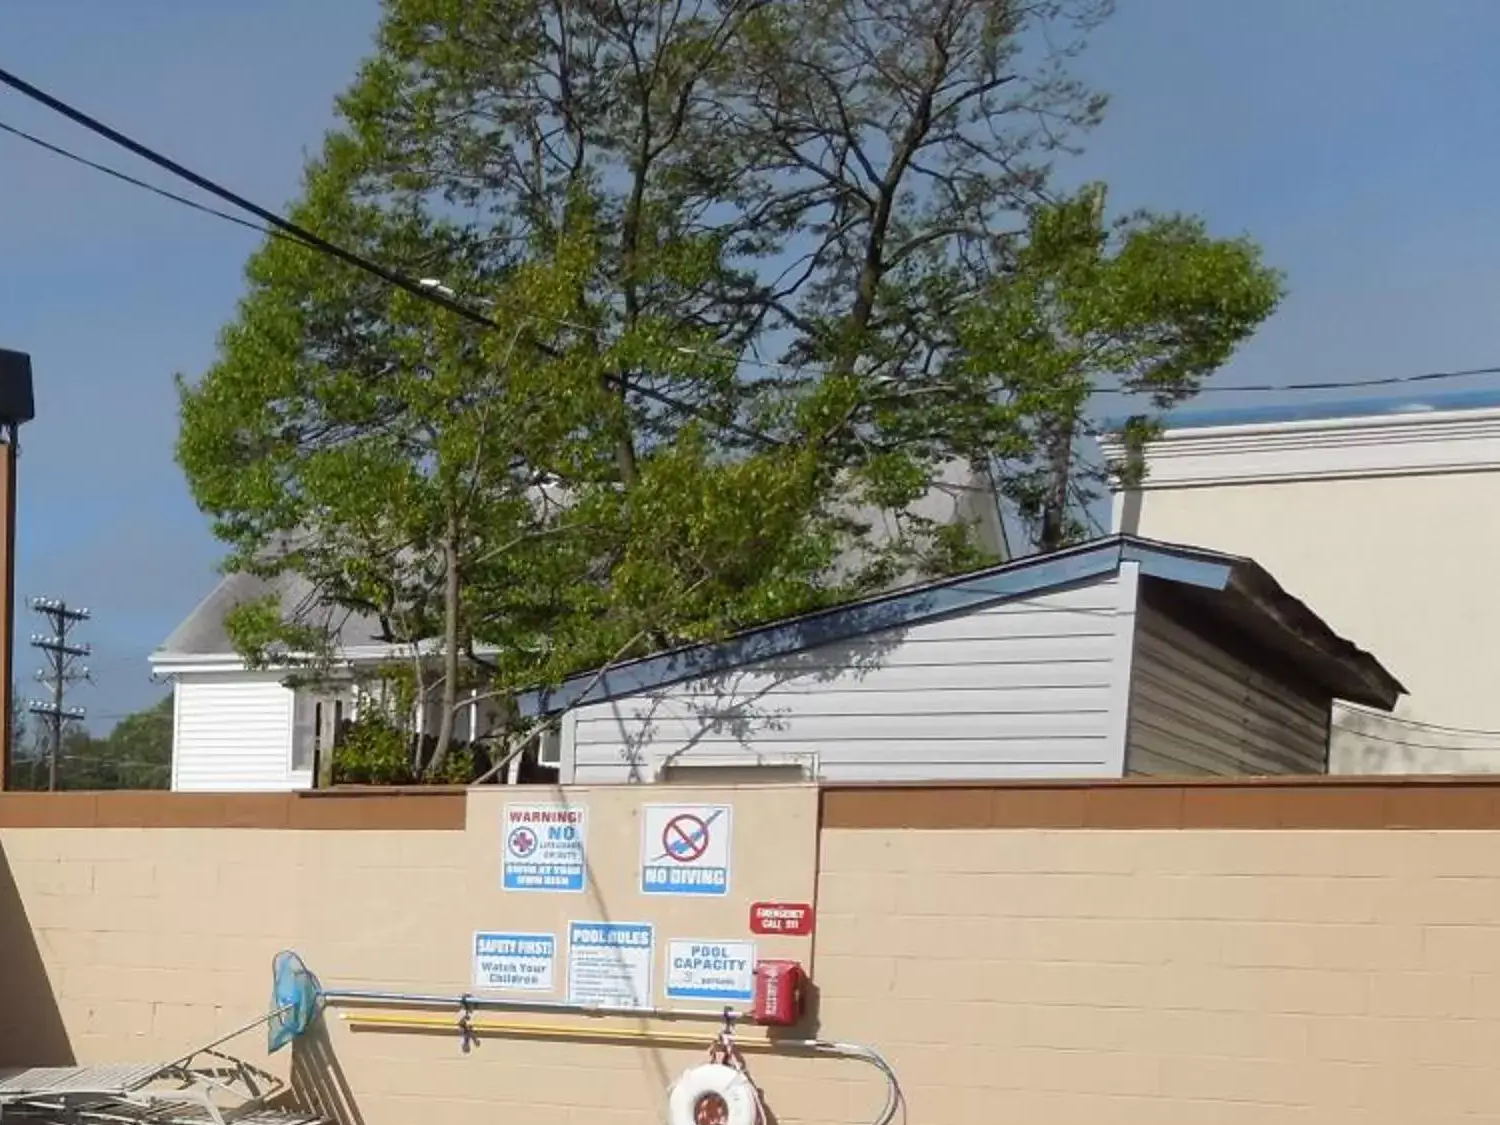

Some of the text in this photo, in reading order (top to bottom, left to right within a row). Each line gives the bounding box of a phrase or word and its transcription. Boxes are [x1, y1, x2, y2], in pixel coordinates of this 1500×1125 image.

[509, 811, 582, 823] WARNING!
[549, 826, 575, 840] NO
[646, 868, 725, 885] NO DIVING
[762, 919, 781, 929] CALL
[573, 929, 649, 945] POOL RULES
[479, 939, 516, 953] SAFETY
[691, 945, 729, 957] POOL
[481, 962, 547, 973] Watch Your
[673, 958, 747, 971] CAPACITY
[489, 974, 539, 984] Children
